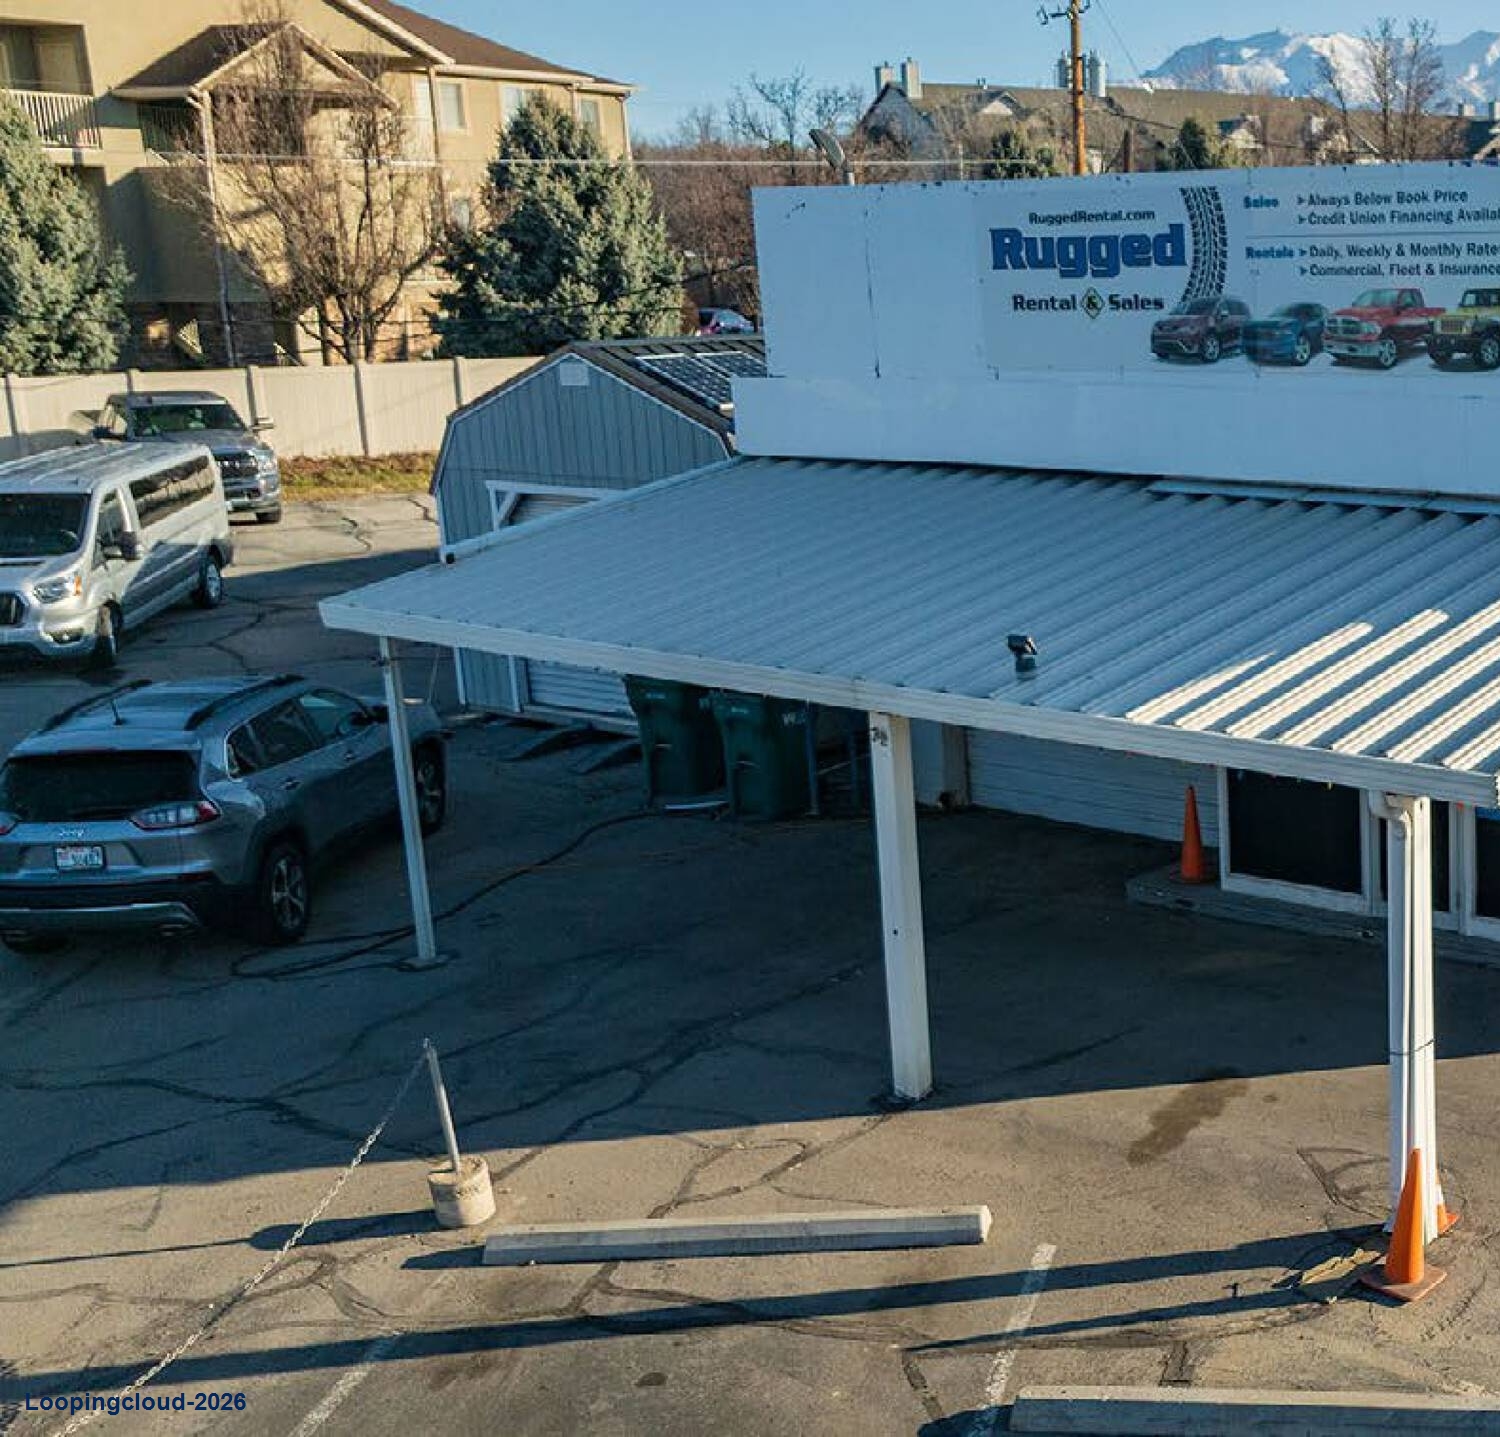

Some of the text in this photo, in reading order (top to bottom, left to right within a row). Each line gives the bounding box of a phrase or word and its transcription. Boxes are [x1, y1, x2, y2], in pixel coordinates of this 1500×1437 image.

[1244, 196, 1279, 209] Sales
[1307, 190, 1468, 208] Always Below Book Price
[1029, 210, 1155, 226] RuggedRental.com
[1307, 212, 1345, 225] Credit
[1350, 210, 1386, 224] Union
[1391, 209, 1453, 225] Financing
[989, 223, 1188, 279] Rugged
[1347, 244, 1391, 259] Weekly
[1395, 243, 1405, 257] &
[1410, 242, 1462, 258] Monthly
[1390, 263, 1420, 276] Fleet
[1425, 263, 1434, 275] &
[1012, 294, 1077, 312] Rental
[1108, 293, 1165, 312] Sales
